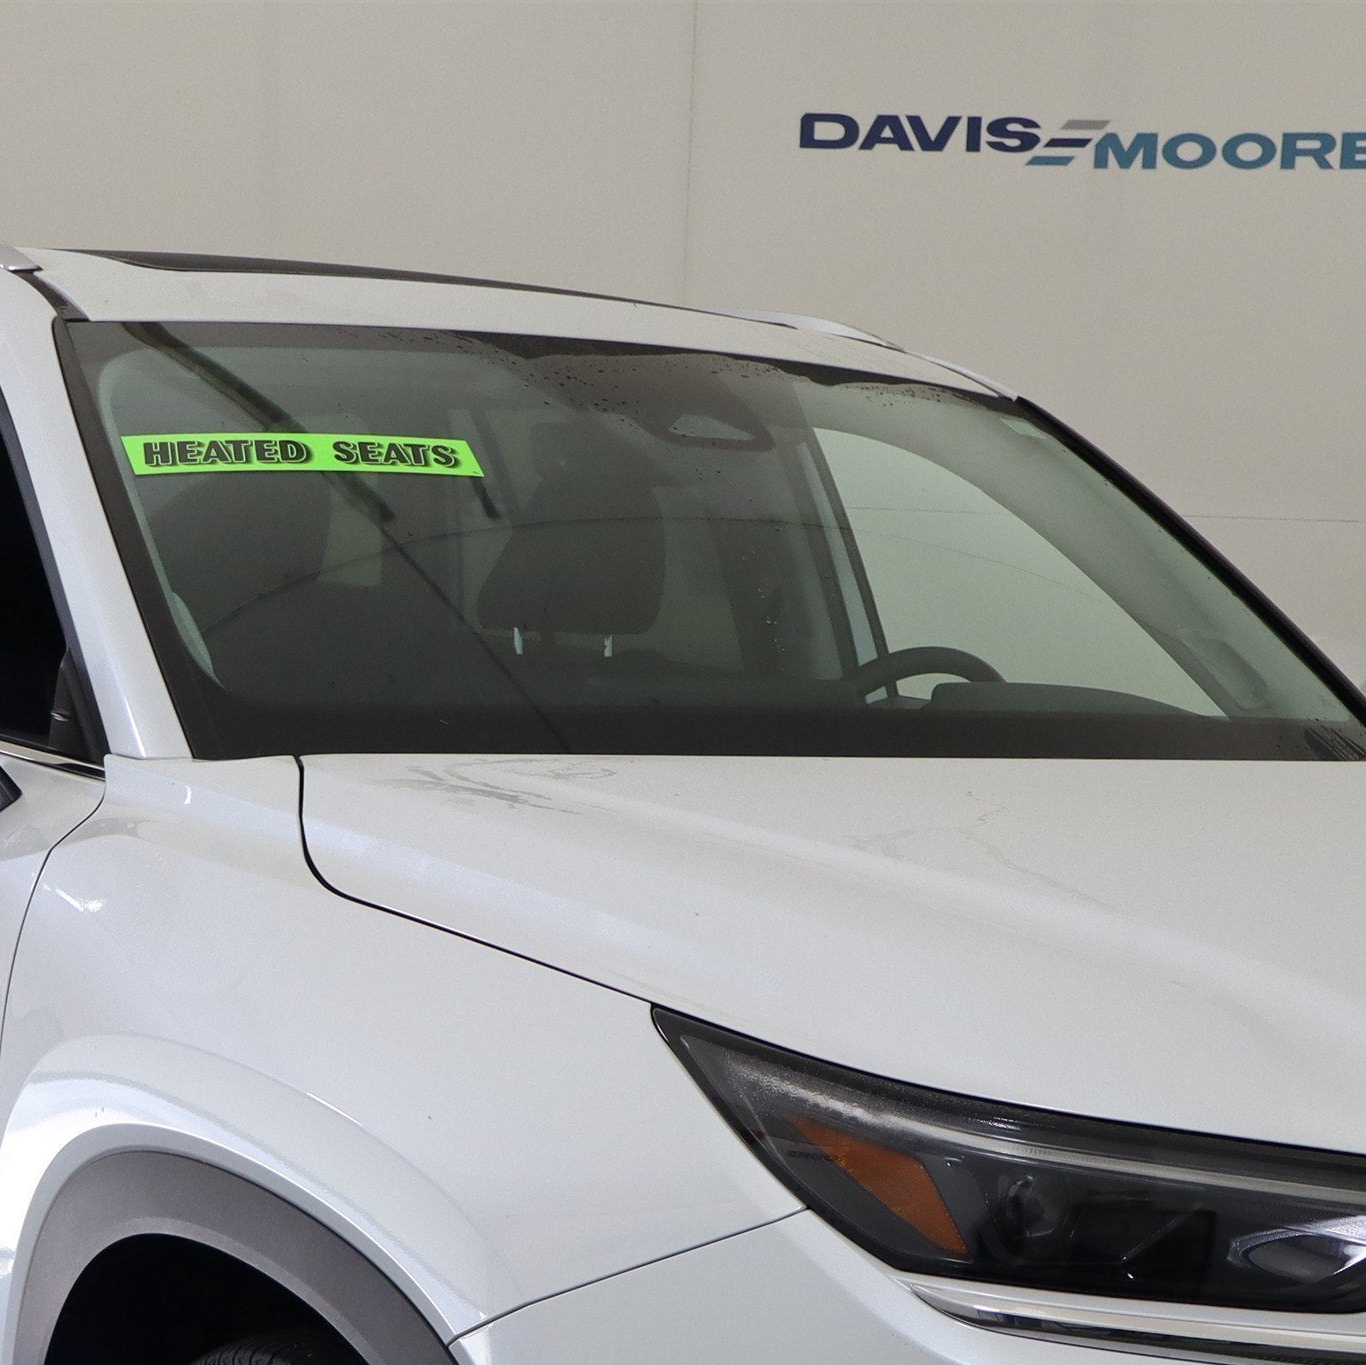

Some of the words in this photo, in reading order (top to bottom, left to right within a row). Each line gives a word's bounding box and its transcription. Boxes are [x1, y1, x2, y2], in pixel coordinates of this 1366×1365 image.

[799, 112, 1042, 154] DAVIS
[142, 439, 313, 467] HEATED
[332, 440, 461, 468] SEATS
